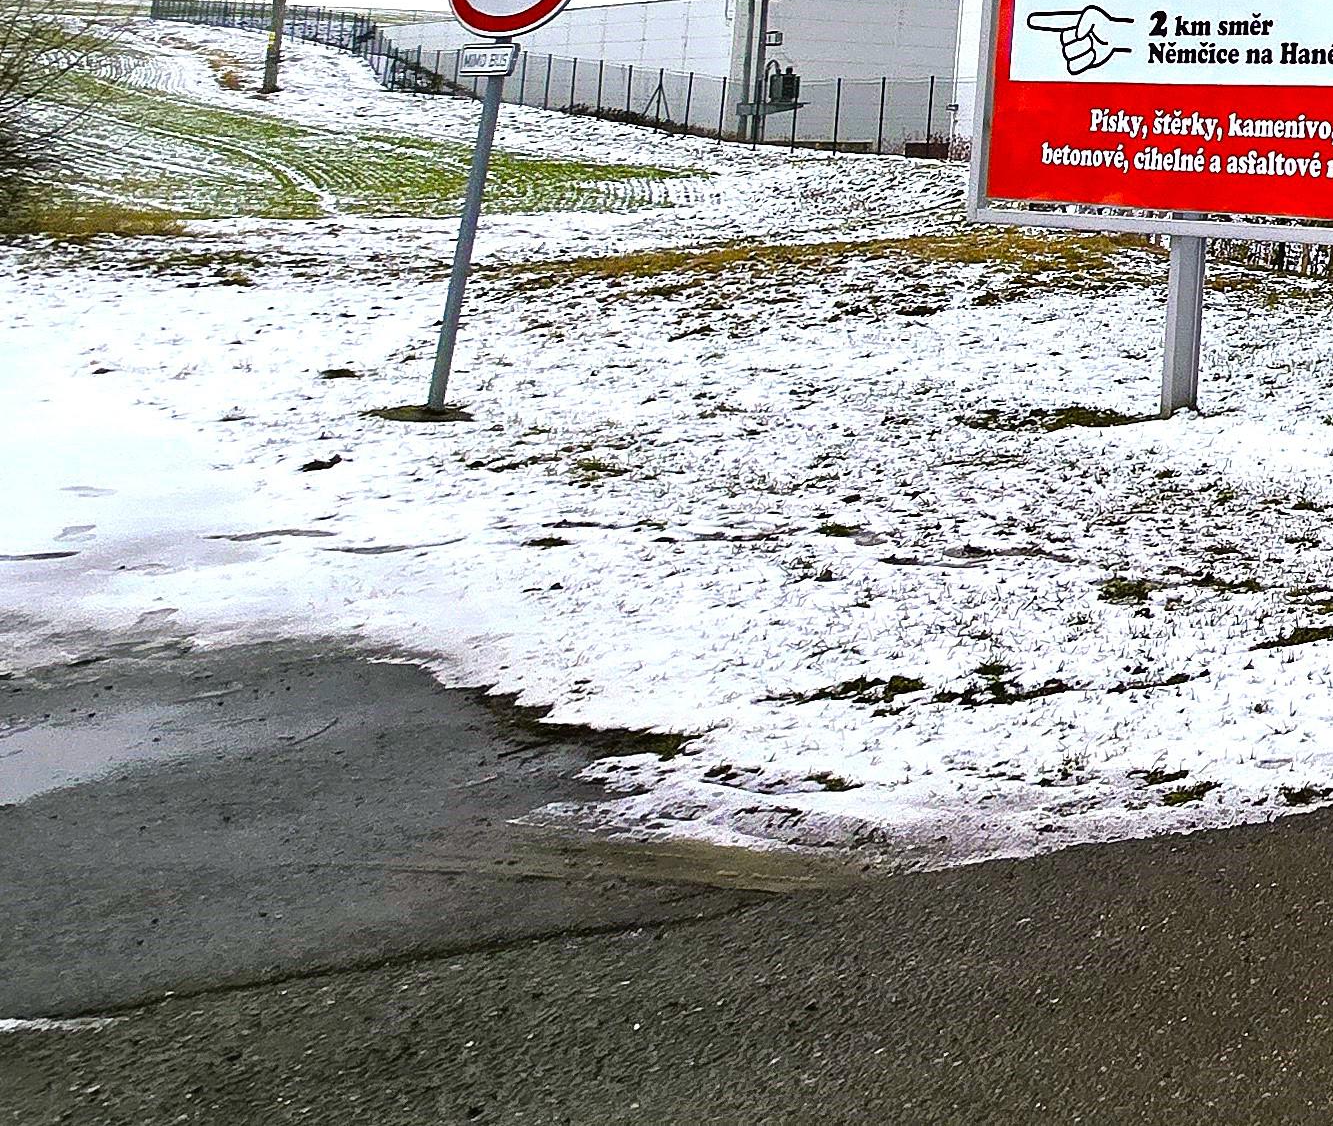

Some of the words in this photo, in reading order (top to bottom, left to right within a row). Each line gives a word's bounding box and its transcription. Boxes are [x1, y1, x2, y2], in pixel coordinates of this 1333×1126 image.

[1149, 11, 1168, 36] 2
[1175, 15, 1211, 37] km
[1216, 17, 1274, 37] směr
[1147, 42, 1240, 65] Němčice
[1246, 47, 1273, 65] na
[1089, 108, 1148, 140] Písky,
[1152, 112, 1223, 142] štěrky,
[1041, 142, 1129, 173] betonové,
[1133, 148, 1204, 172] cihelné
[1208, 157, 1221, 174] a
[1226, 150, 1321, 179] asfaltové
